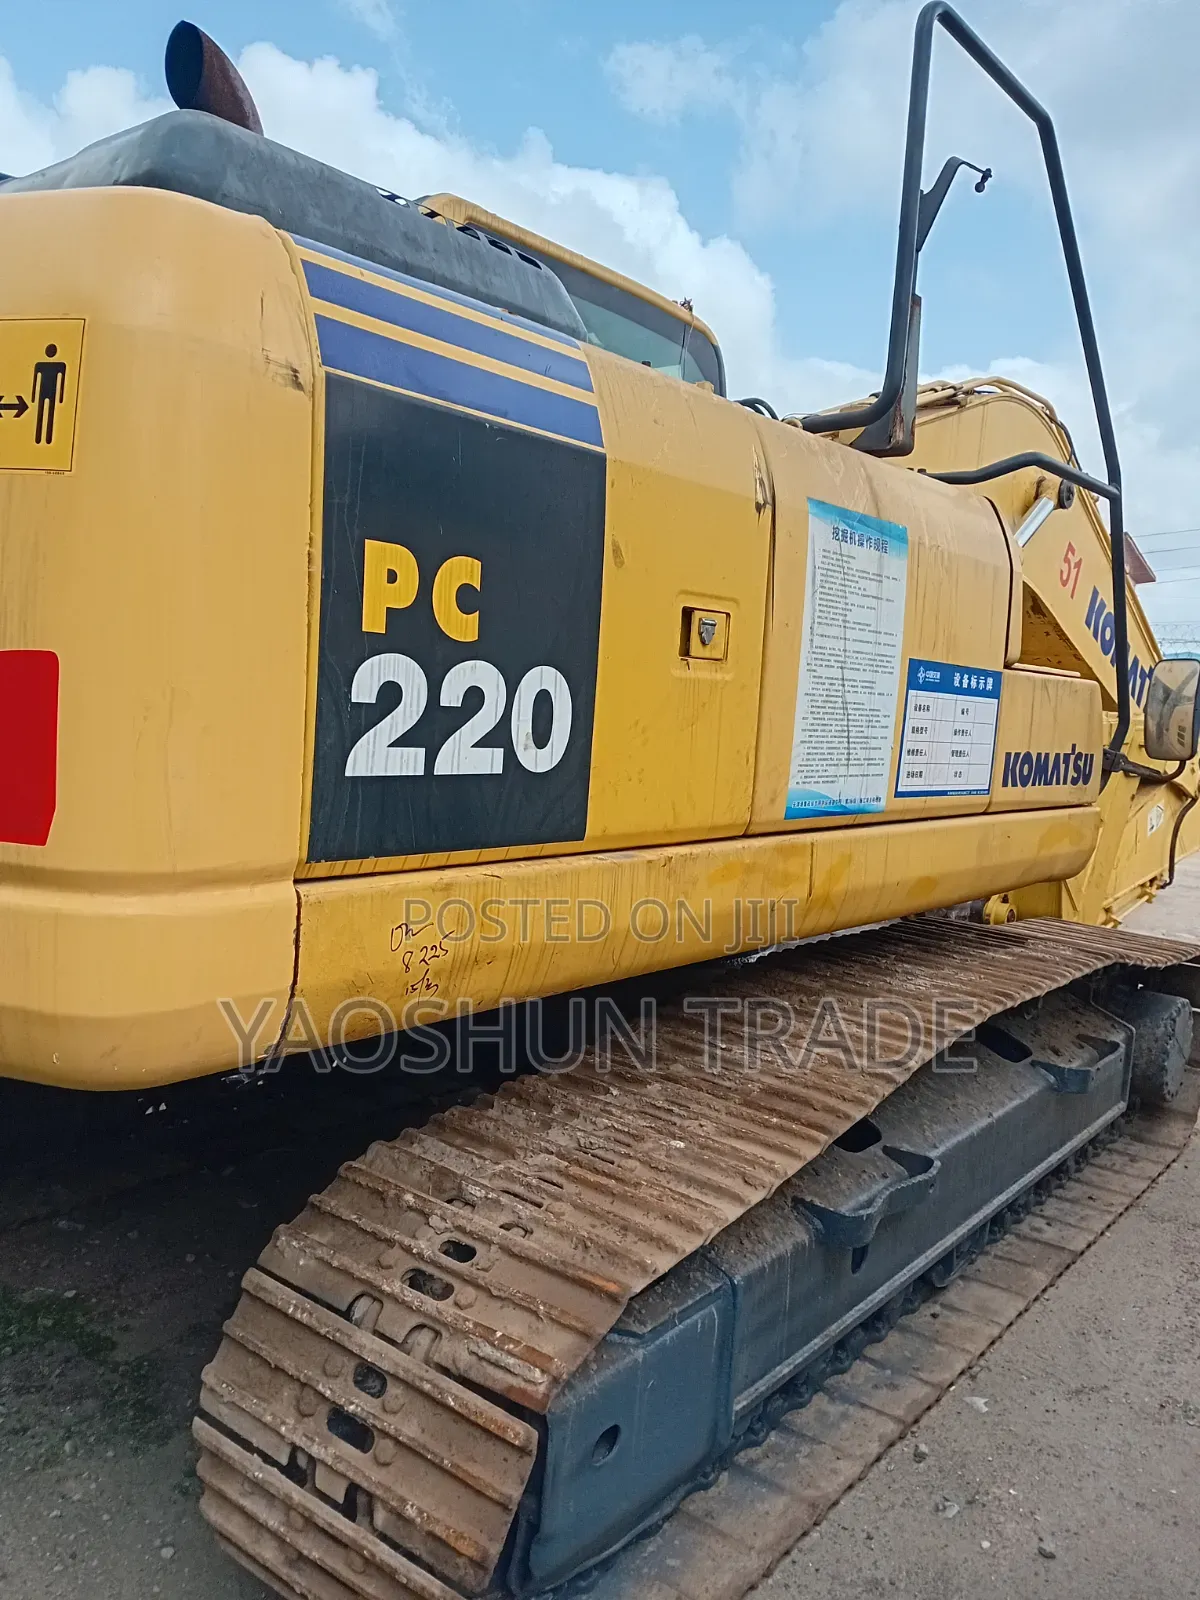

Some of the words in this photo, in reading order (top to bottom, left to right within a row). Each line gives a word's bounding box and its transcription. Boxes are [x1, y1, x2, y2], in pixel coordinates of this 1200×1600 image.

[831, 525, 889, 554] 挖掘机操作规程
[361, 538, 482, 643] PC
[1059, 541, 1084, 600] 51
[953, 672, 994, 692] 设备标示牌
[344, 652, 573, 777] 220
[1002, 743, 1094, 787] KOMATSU
